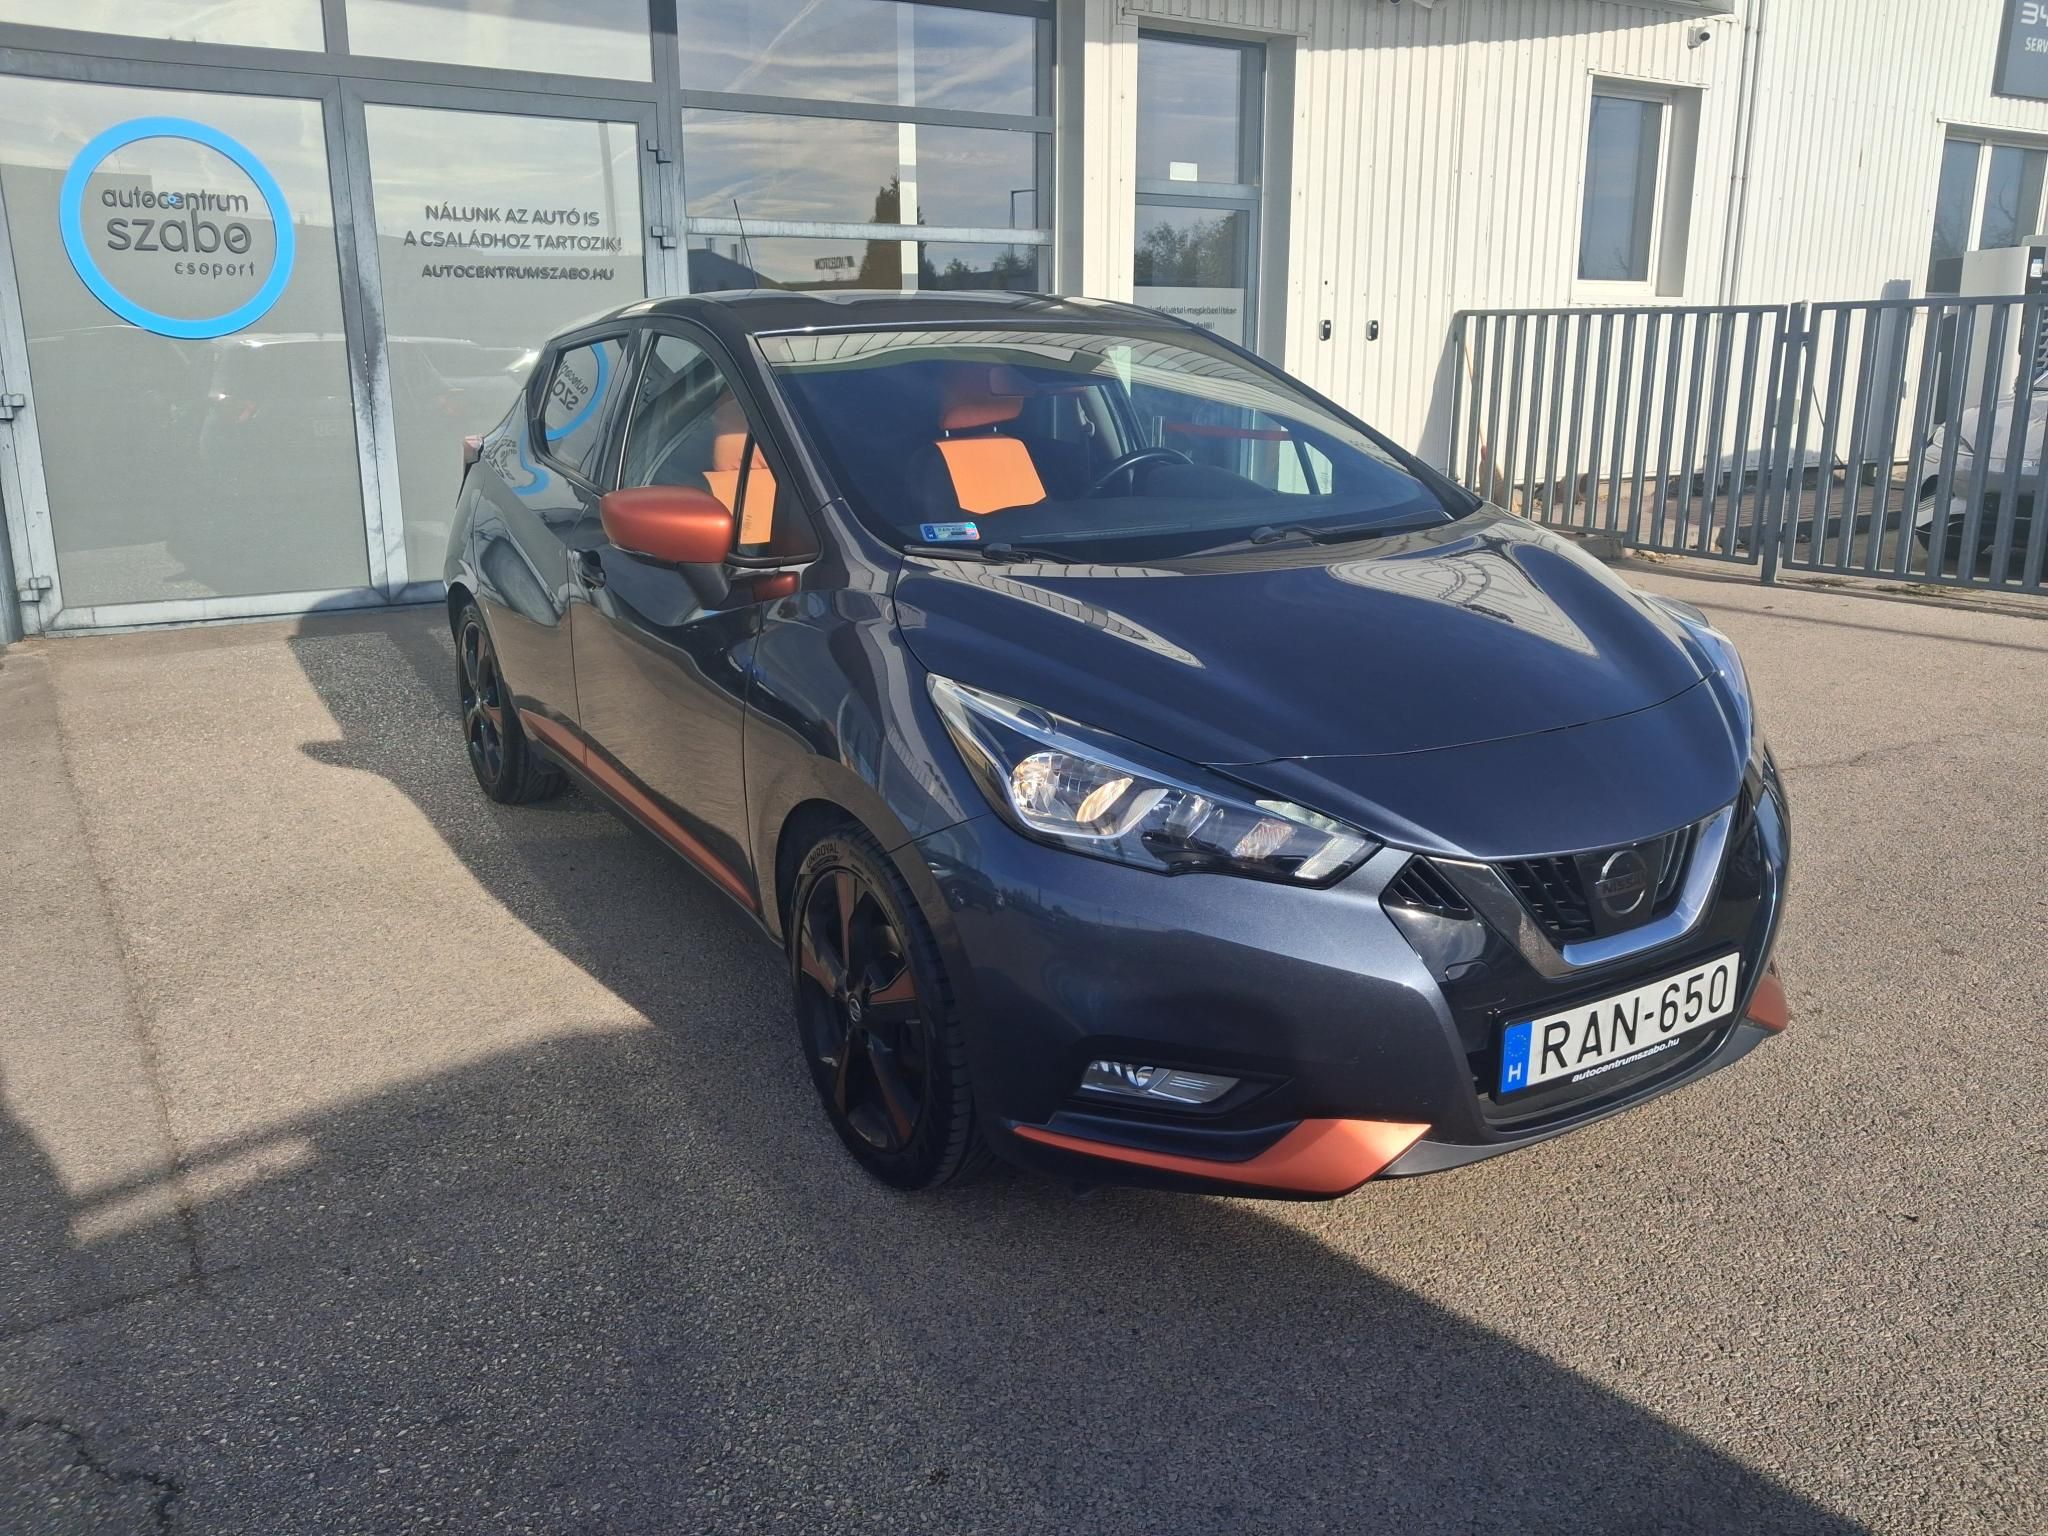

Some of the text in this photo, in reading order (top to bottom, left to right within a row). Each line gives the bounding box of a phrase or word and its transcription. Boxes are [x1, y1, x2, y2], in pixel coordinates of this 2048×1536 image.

[101, 186, 249, 213] autocentrum
[425, 201, 600, 226] NÁLUNK AZ AUTÓ IS
[403, 229, 622, 252] A CSALÁDHOZ TARTOZIK!
[174, 261, 255, 279] csoport
[421, 264, 615, 281] AUTOCENTRUMSZABO.HU
[806, 841, 839, 869] UNIROYAL
[1540, 964, 1729, 1075] RAN-650
[1507, 1061, 1522, 1083] H
[1571, 1037, 1681, 1083] autocentrumszabo.hu
